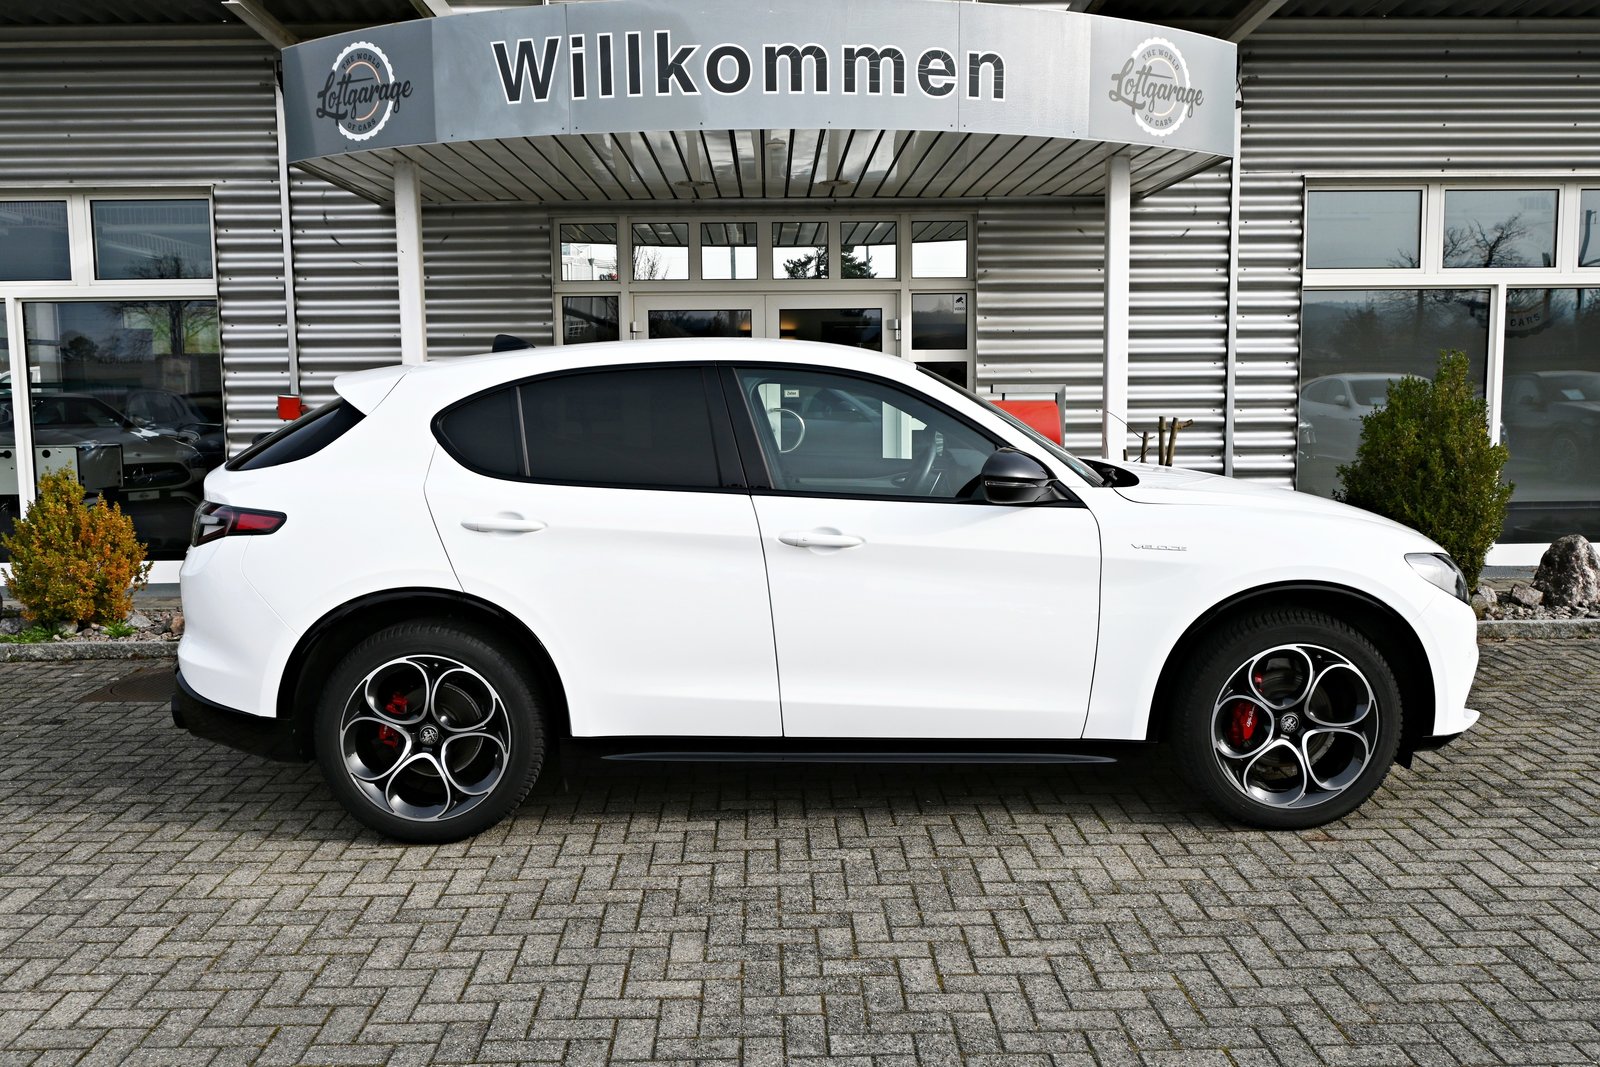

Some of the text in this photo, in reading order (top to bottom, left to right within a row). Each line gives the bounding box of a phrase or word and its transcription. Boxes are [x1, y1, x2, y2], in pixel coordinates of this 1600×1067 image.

[342, 53, 380, 69] THE WORLD
[490, 29, 1007, 104] Willkommen
[1142, 49, 1180, 71] THE WORLD
[316, 70, 413, 126] Loftgarage
[1108, 57, 1204, 118] Loftgarage
[348, 118, 376, 131] OF CARS
[1155, 116, 1173, 126] CARS
